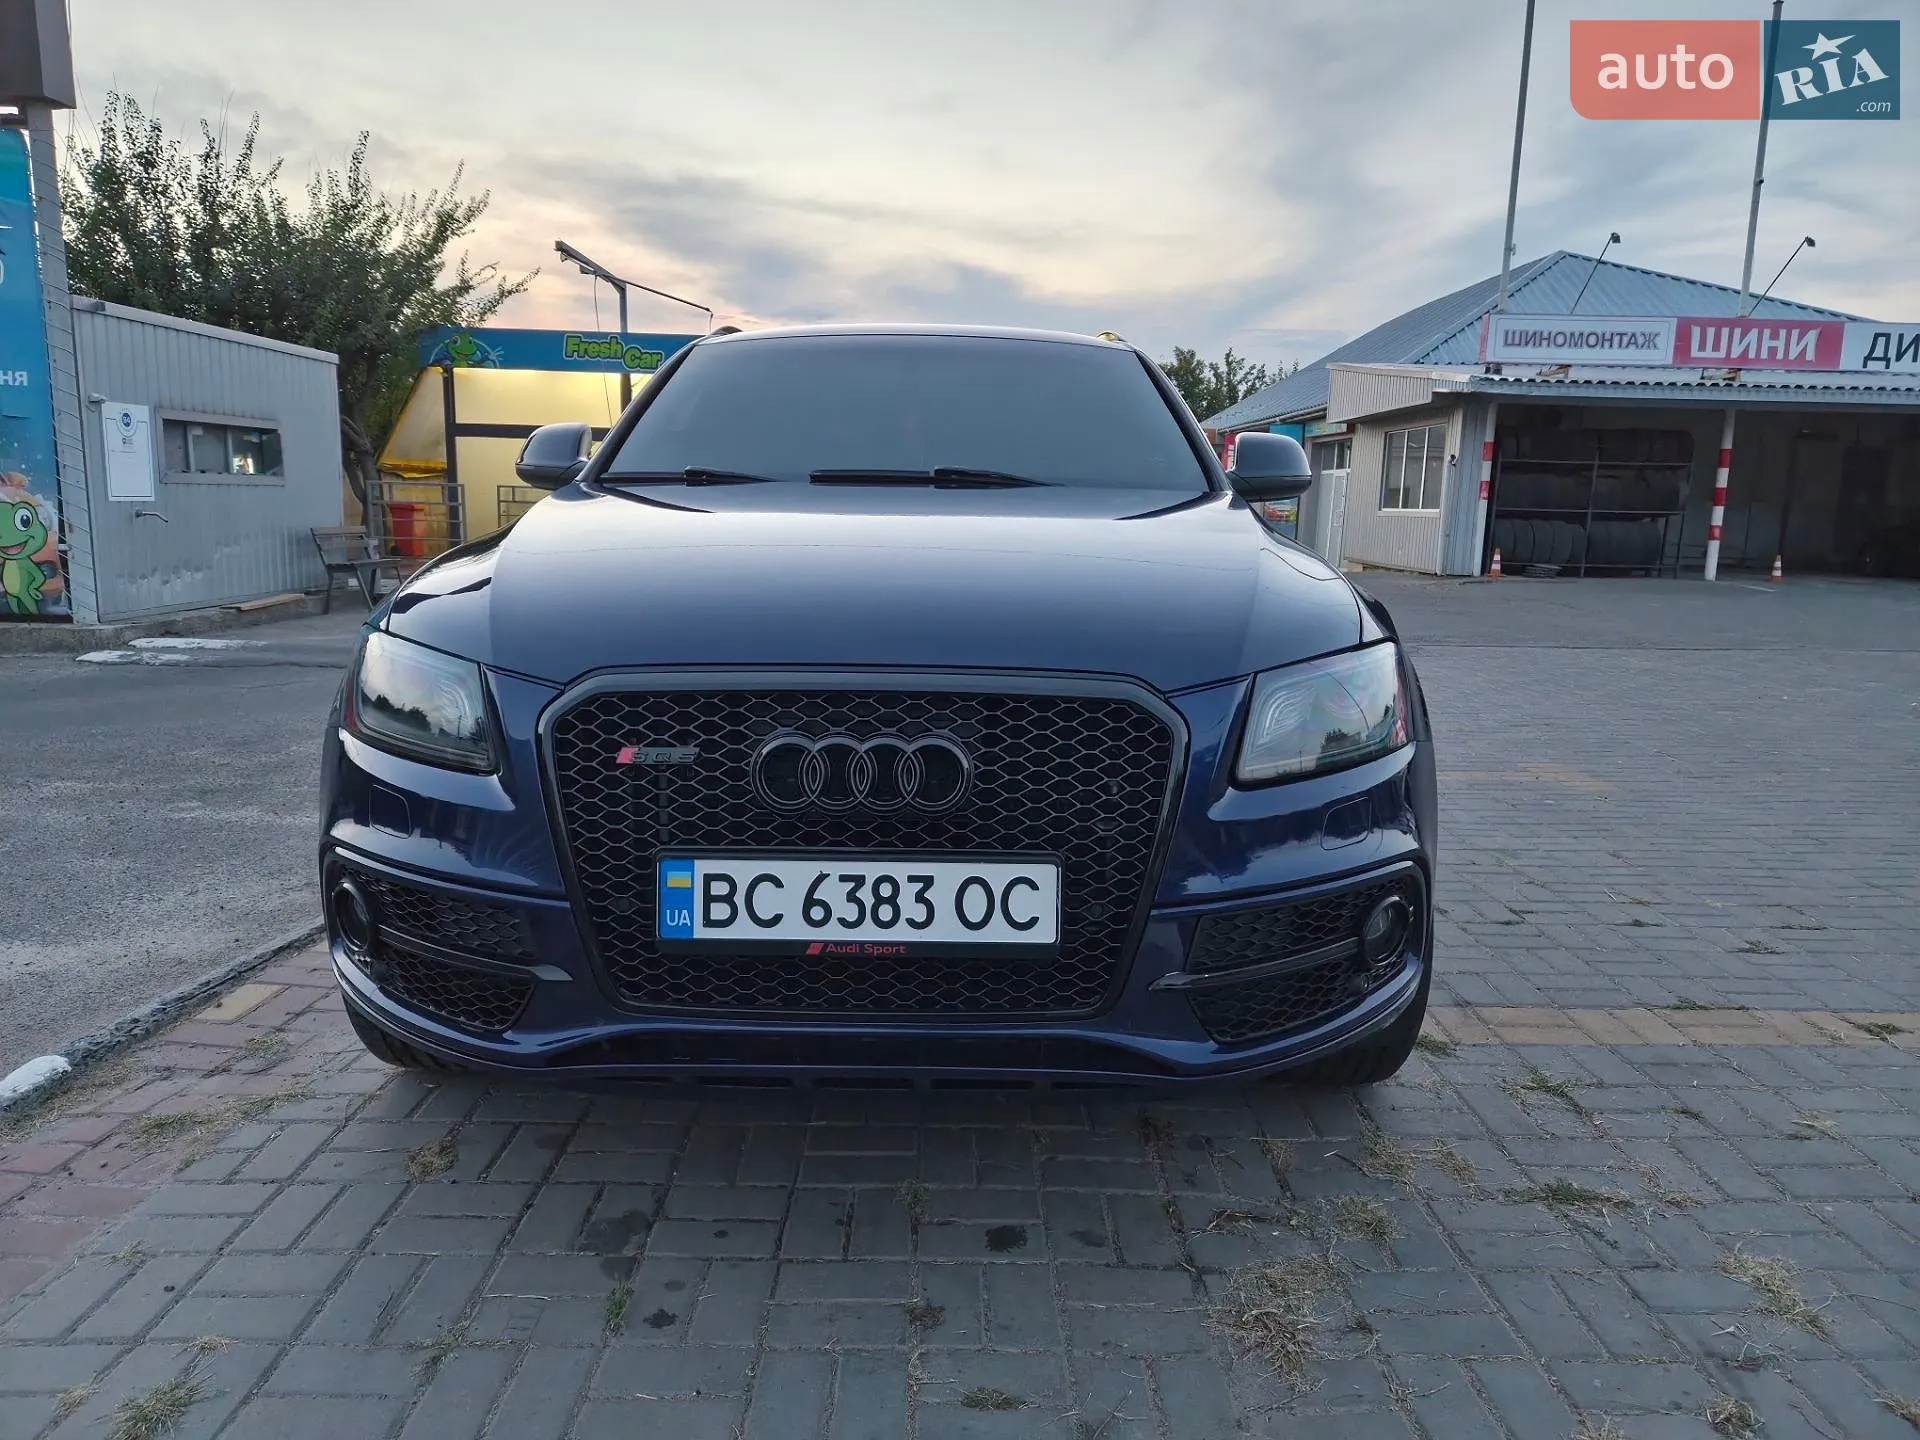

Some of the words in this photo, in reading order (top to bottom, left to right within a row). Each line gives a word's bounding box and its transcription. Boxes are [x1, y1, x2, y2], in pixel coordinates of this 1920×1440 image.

[564, 334, 624, 360] Fresh
[623, 346, 663, 370] Car
[1502, 328, 1661, 350] ШИНОМОНТАЖ
[1690, 324, 1822, 362] ШИНИ
[702, 873, 785, 928] BC
[801, 871, 936, 930] 6383
[954, 875, 1040, 931] OC
[666, 909, 691, 926] UA
[825, 943, 862, 954] Audi
[864, 943, 906, 956] Sport
